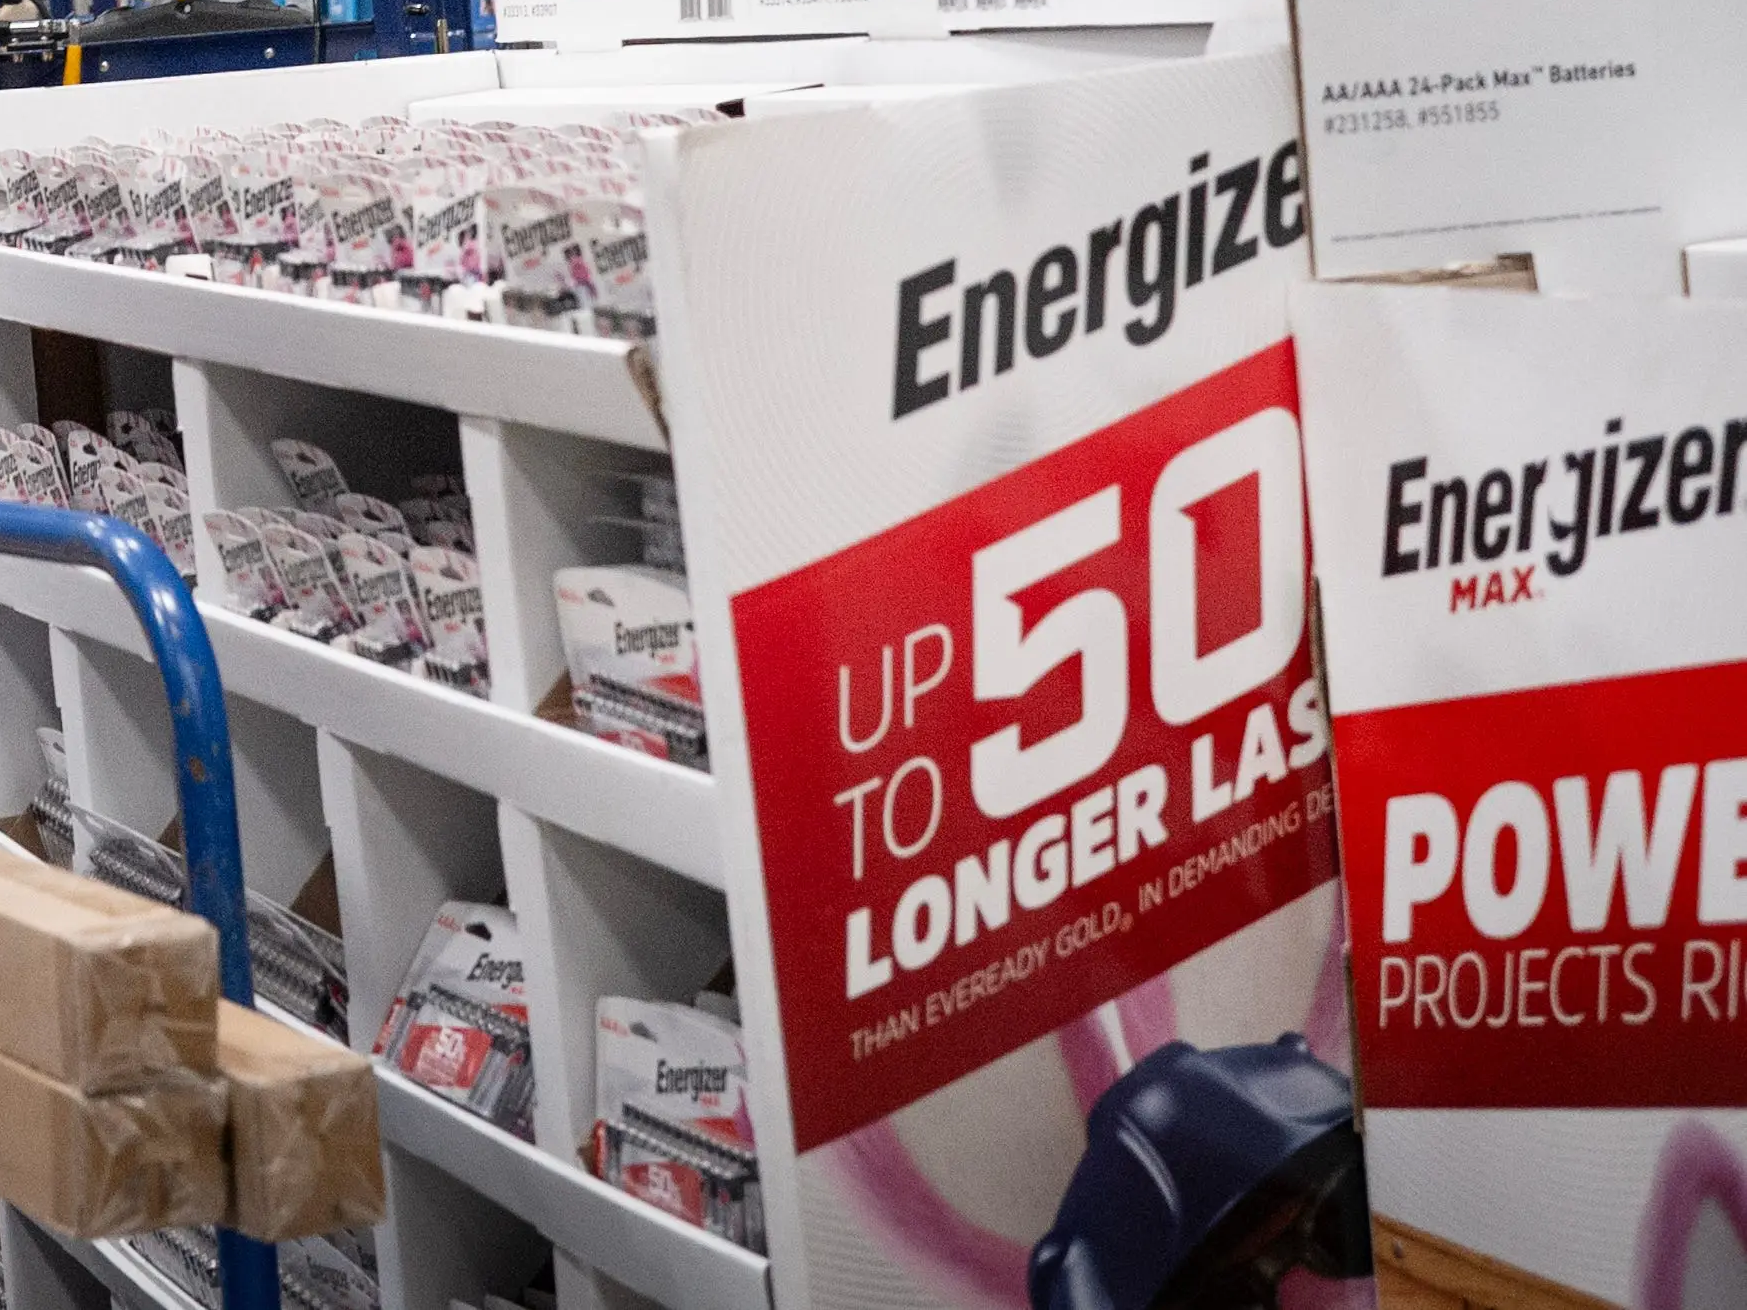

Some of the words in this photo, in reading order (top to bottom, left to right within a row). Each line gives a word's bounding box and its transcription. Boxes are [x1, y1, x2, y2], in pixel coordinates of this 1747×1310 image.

[1322, 78, 1402, 104] AA/AAA
[1408, 72, 1487, 97] 24-Pack
[1549, 61, 1636, 84] Batteries
[1417, 100, 1502, 126] #551855
[1449, 564, 1539, 615] MAX
[838, 623, 953, 754] UP
[834, 755, 943, 881] TO
[846, 763, 1170, 1001] LONGER
[849, 1009, 919, 1063] THAN
[925, 932, 1051, 1028] EVEREADY
[1138, 882, 1164, 914] IN
[1167, 802, 1301, 901] DEMANDING
[1380, 943, 1656, 1032] PROJECTS
[657, 1058, 728, 1102] Energizer
